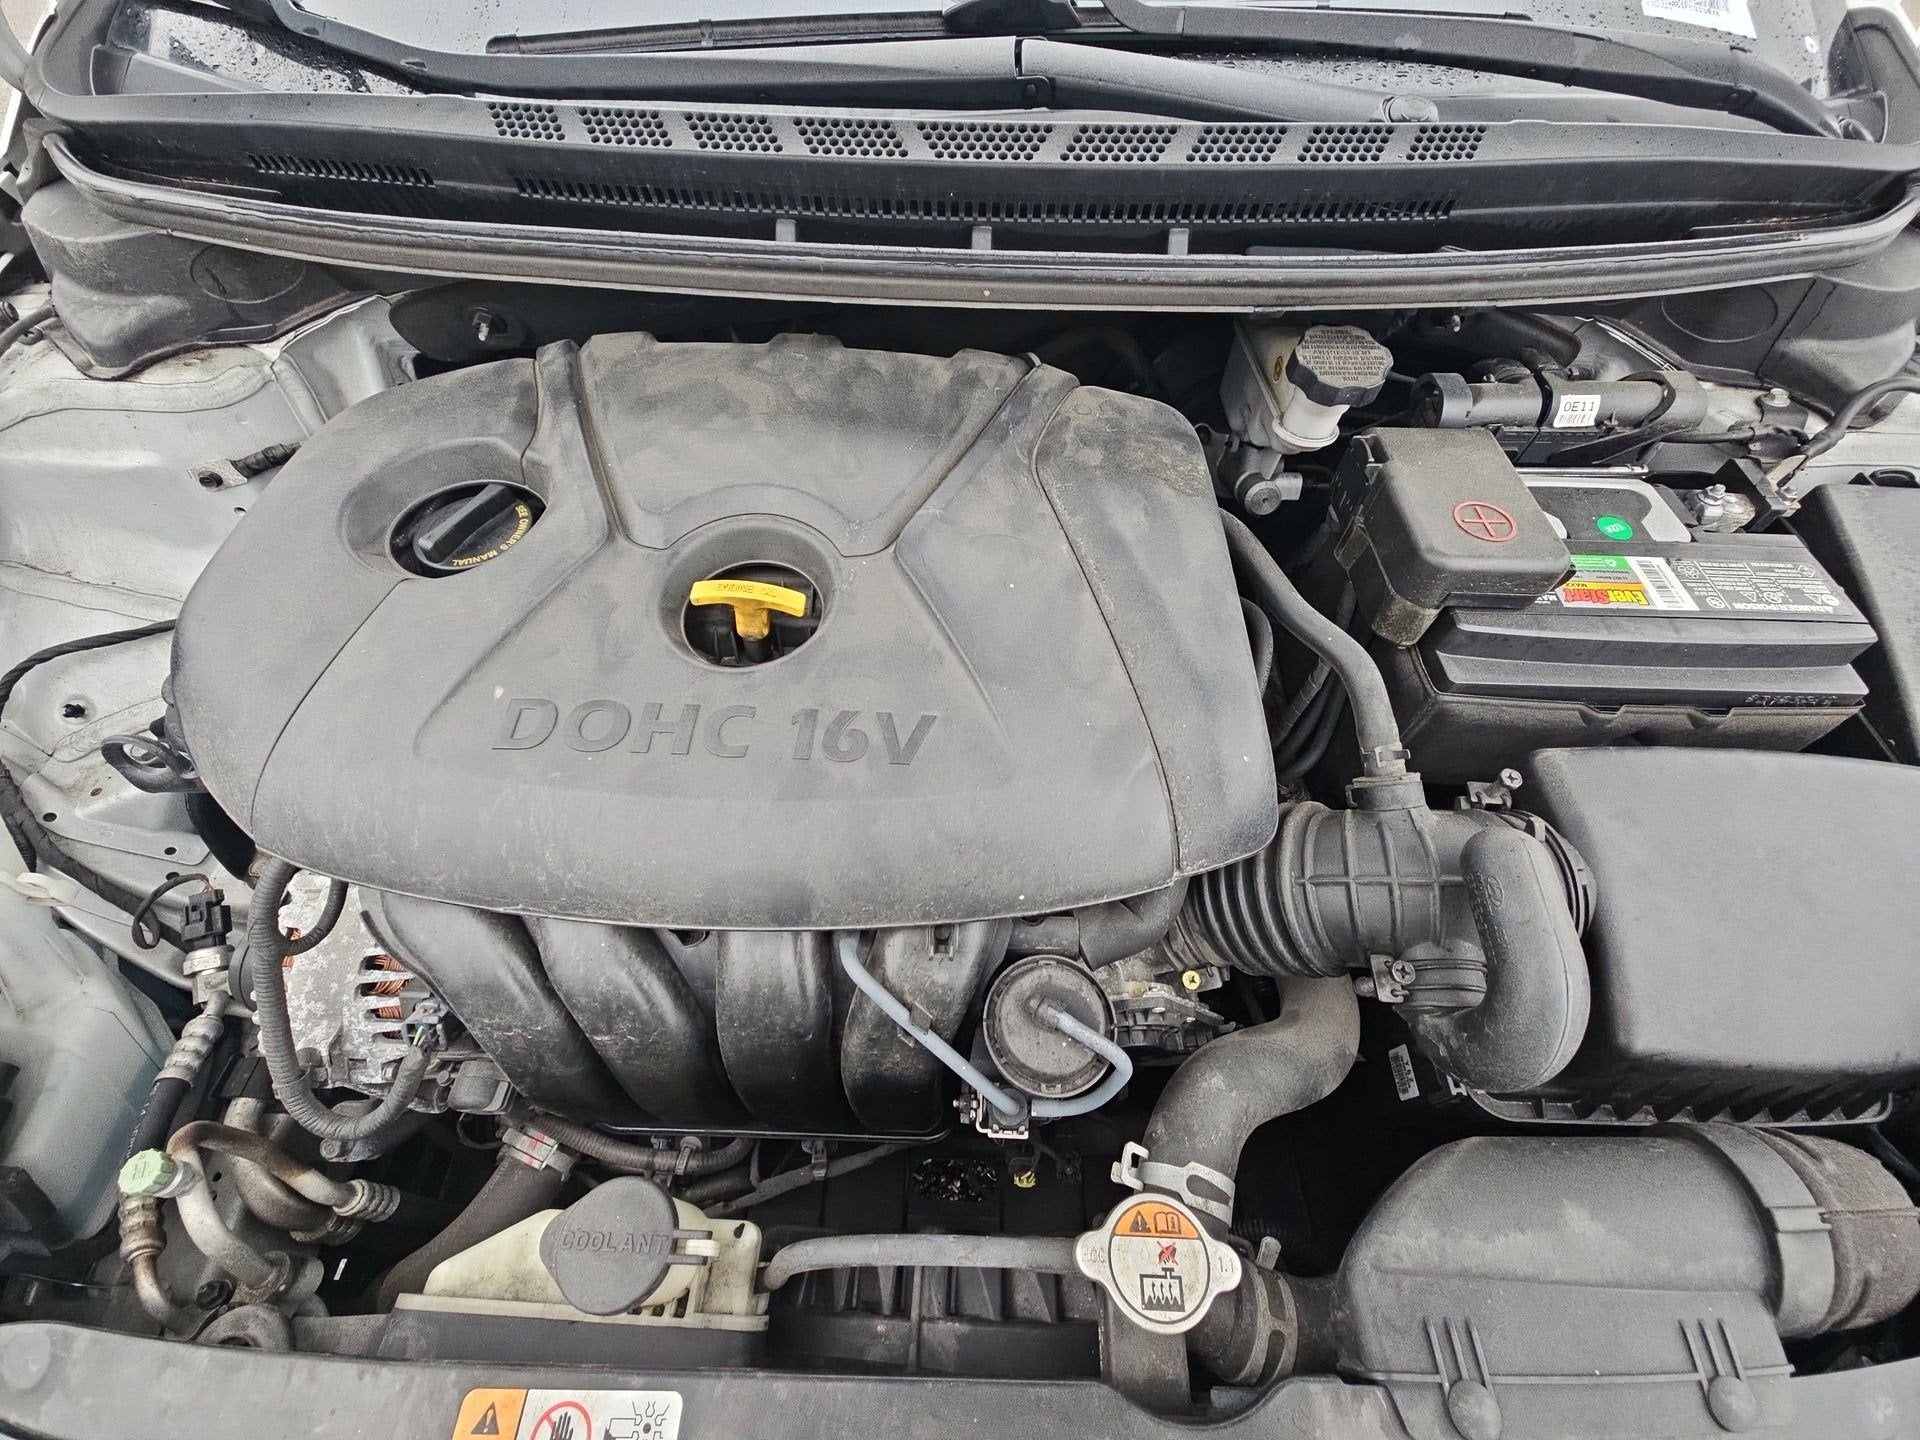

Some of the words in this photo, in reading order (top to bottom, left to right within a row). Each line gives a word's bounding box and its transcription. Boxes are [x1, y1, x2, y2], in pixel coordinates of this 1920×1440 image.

[514, 504, 529, 518] SEE
[499, 518, 530, 551] OWNER'S
[452, 549, 499, 567] MANUAL
[716, 583, 754, 594] ENGINE
[1563, 588, 1649, 606] EverStart
[490, 697, 758, 759] DOHC
[789, 707, 939, 766] 16V
[561, 1230, 670, 1255] COOLANT
